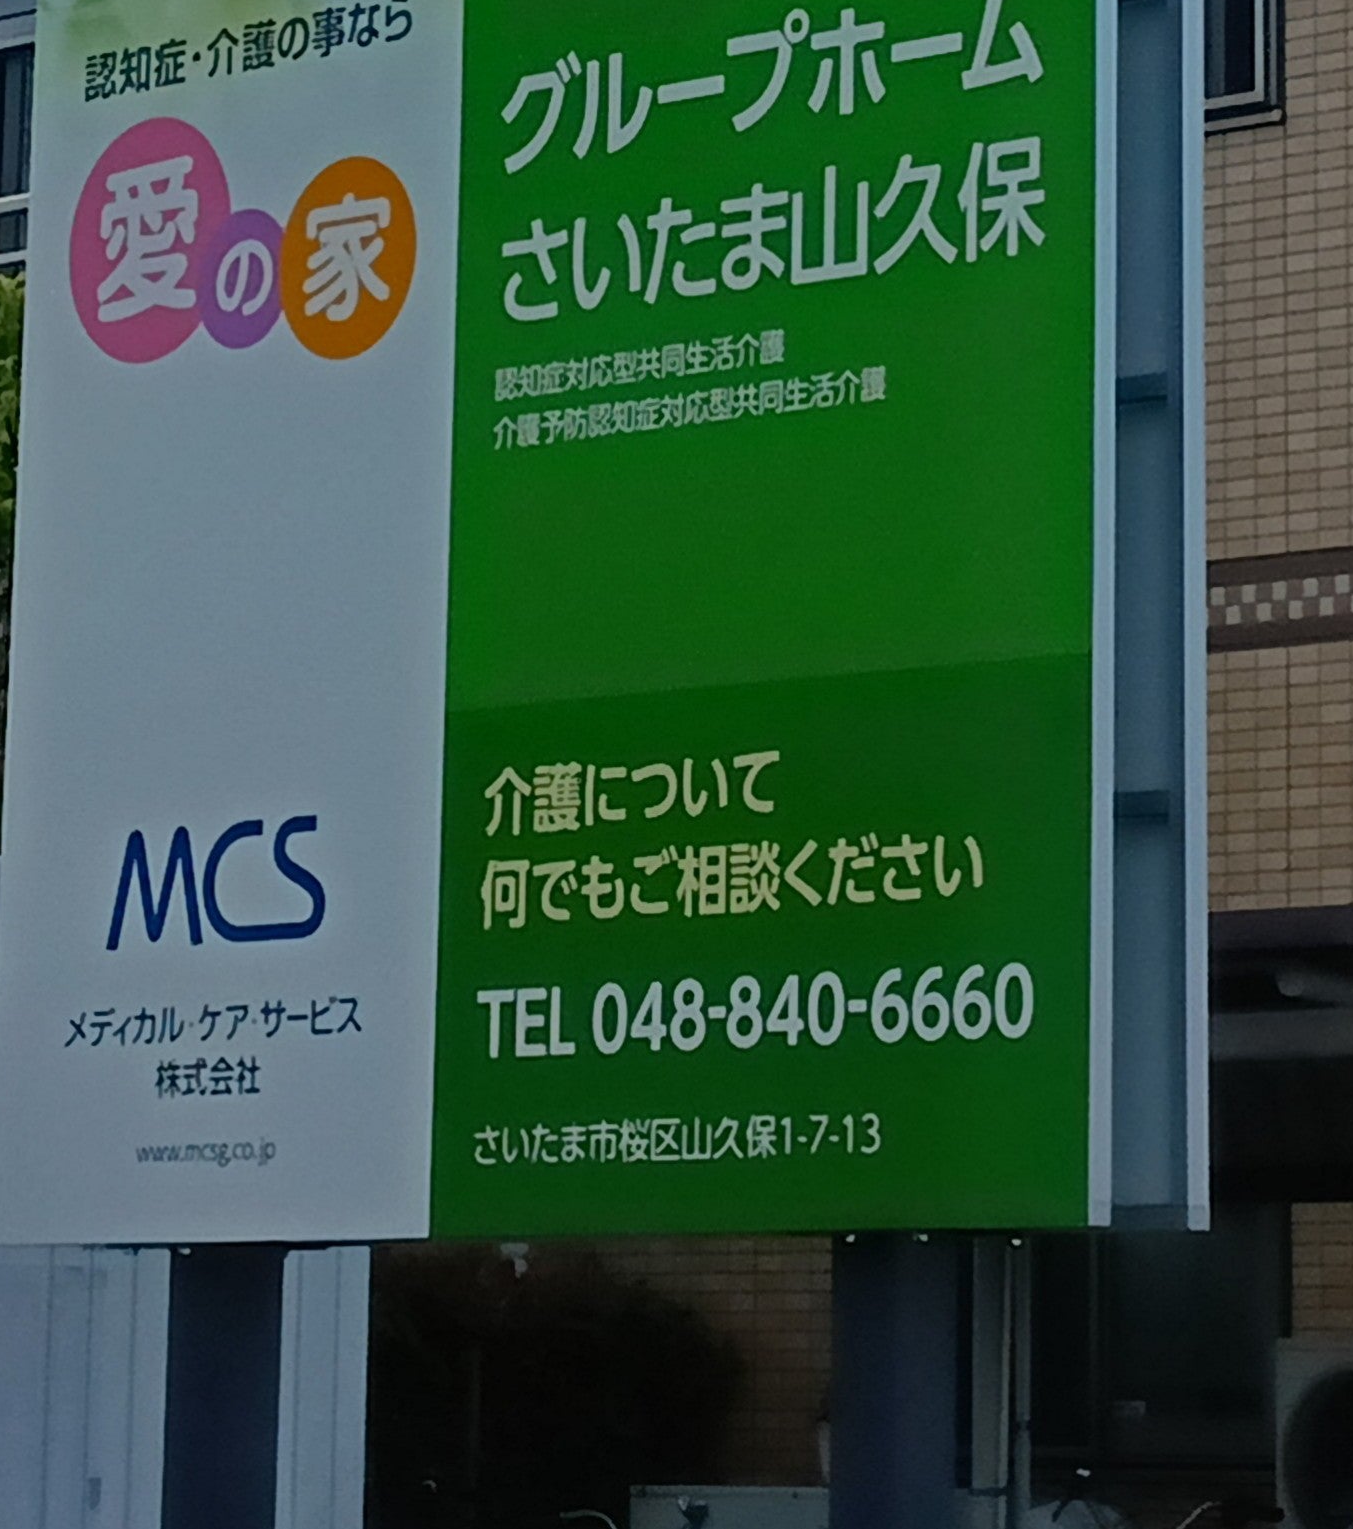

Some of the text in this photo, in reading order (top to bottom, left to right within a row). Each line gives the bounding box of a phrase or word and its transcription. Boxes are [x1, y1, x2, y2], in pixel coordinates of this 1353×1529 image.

[97, 155, 392, 322] 愛の家
[501, 136, 1046, 321] さいたま山久保
[493, 328, 785, 402] 認知症対応型共同生活介護
[493, 365, 887, 451] 介護予防認知症対応型共同生活介護
[484, 750, 781, 837] 介護について
[105, 814, 326, 951] MCS
[480, 831, 985, 931] 何でもご相談ください
[476, 962, 1034, 1059] TEL 048-840-6660
[154, 1056, 261, 1098] 株式会社
[135, 1137, 277, 1168] www.mcsg.co.jp
[473, 1112, 882, 1166] さいたま市桜区山久保1-7-13
